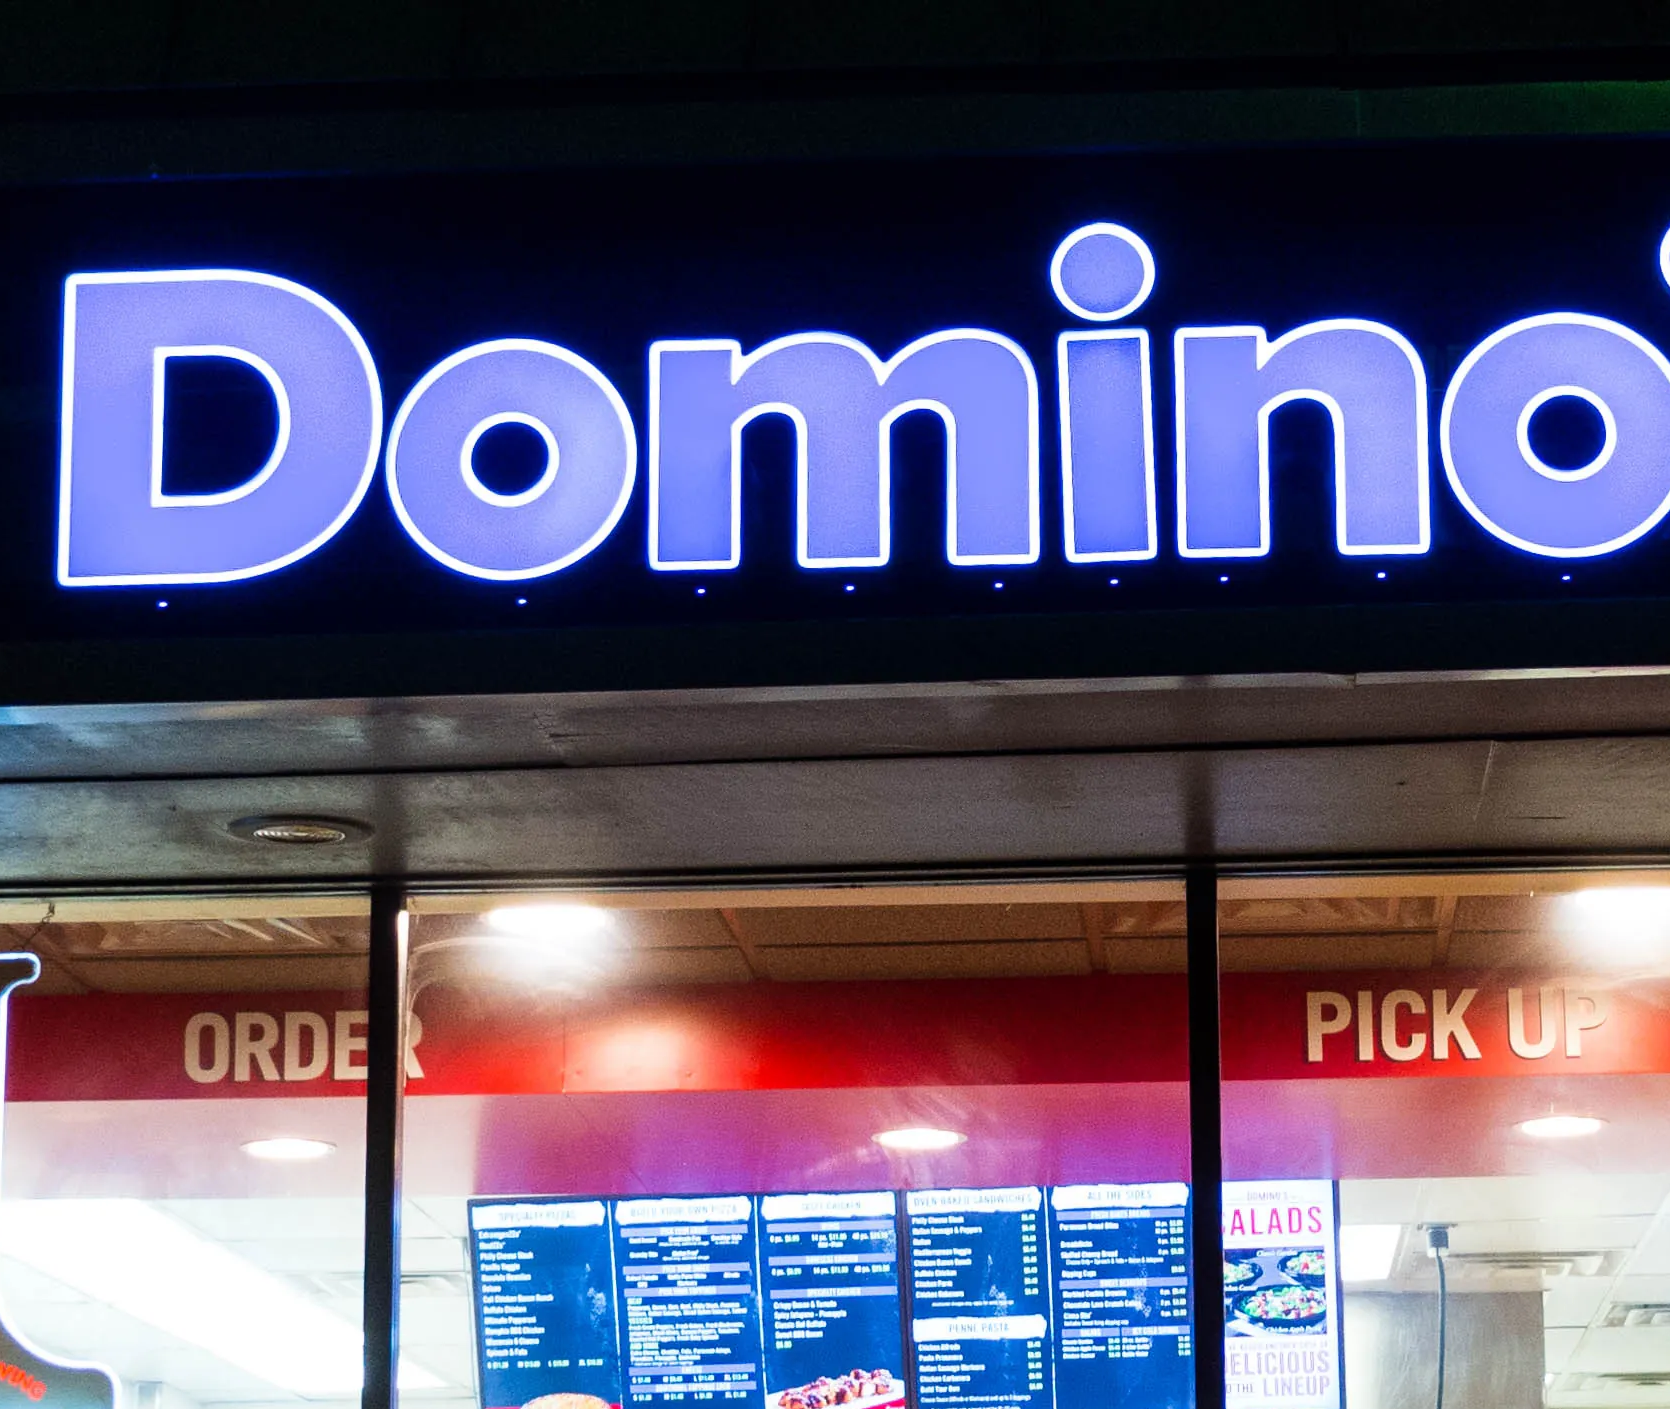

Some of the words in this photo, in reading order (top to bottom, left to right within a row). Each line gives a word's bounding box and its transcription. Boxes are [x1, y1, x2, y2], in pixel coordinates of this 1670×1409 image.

[1305, 987, 1483, 1063] PICK
[1506, 986, 1608, 1060] UP
[1223, 1205, 1323, 1237] ALADS
[1225, 1350, 1331, 1376] ELICIOUS
[1263, 1375, 1331, 1398] LINEUP
